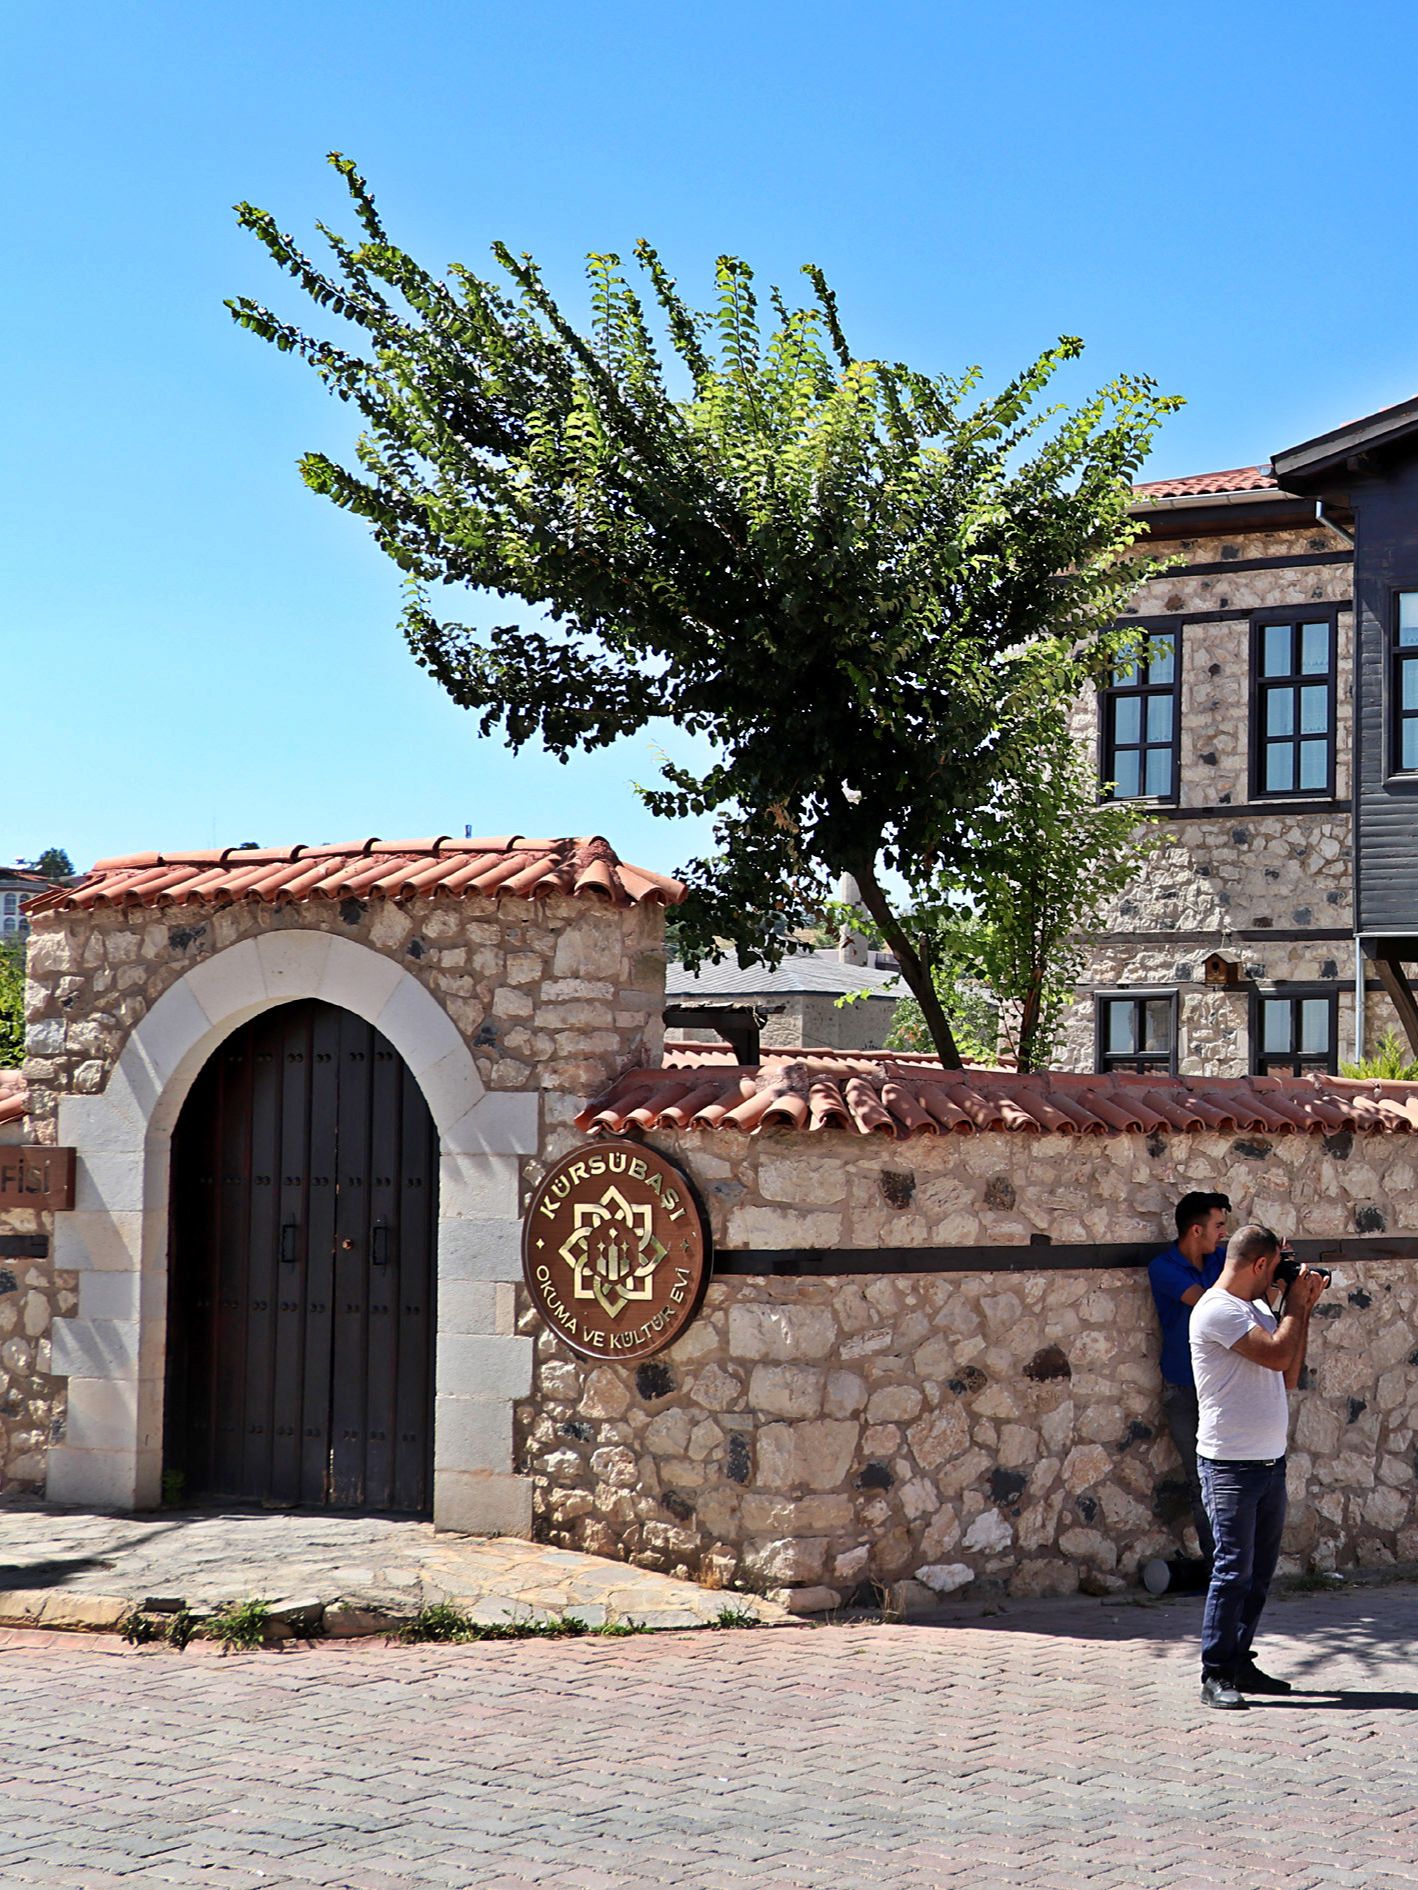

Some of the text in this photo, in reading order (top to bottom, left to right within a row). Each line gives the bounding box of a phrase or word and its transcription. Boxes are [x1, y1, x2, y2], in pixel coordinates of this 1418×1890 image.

[539, 1152, 687, 1222] KÜRSÜBAŞI
[536, 1265, 691, 1350] OKUMA VE KÜLTÜR EVİ
